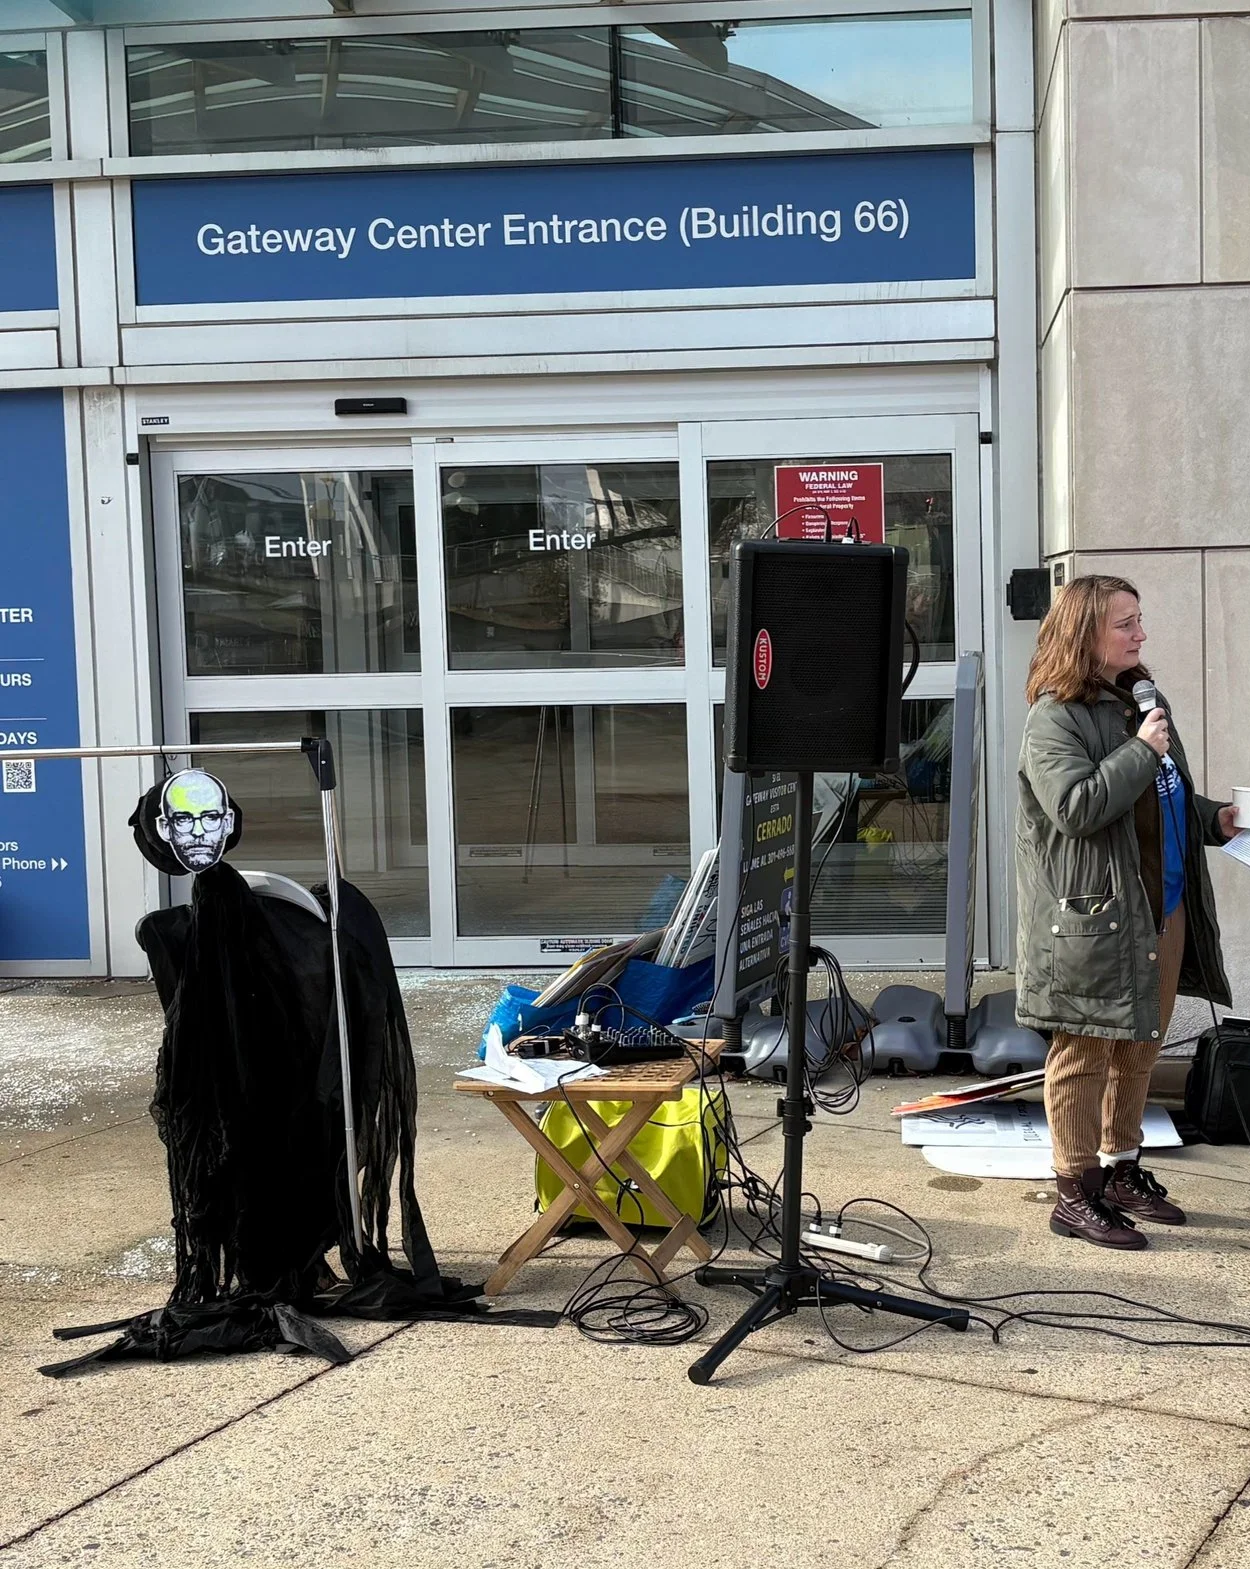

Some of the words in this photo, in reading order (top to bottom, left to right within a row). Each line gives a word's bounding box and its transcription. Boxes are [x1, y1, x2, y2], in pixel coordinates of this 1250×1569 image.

[197, 223, 357, 259] Gateway
[367, 217, 492, 250] Center
[503, 213, 668, 246] Entrance
[679, 204, 842, 248] (Building
[853, 198, 910, 239] 66)
[799, 470, 859, 482] WARNING
[264, 535, 332, 558] Enter
[528, 529, 597, 552] Enter
[758, 637, 768, 681] KUSTOM
[769, 784, 787, 800] VISITOR
[756, 813, 792, 843] CERRADO
[2, 857, 47, 870] Phone
[741, 904, 753, 919] SIGA
[753, 899, 763, 913] LAS
[739, 939, 751, 954] UNA
[751, 929, 773, 948] ENTRADA
[739, 947, 771, 972] ALTERNATIVA
